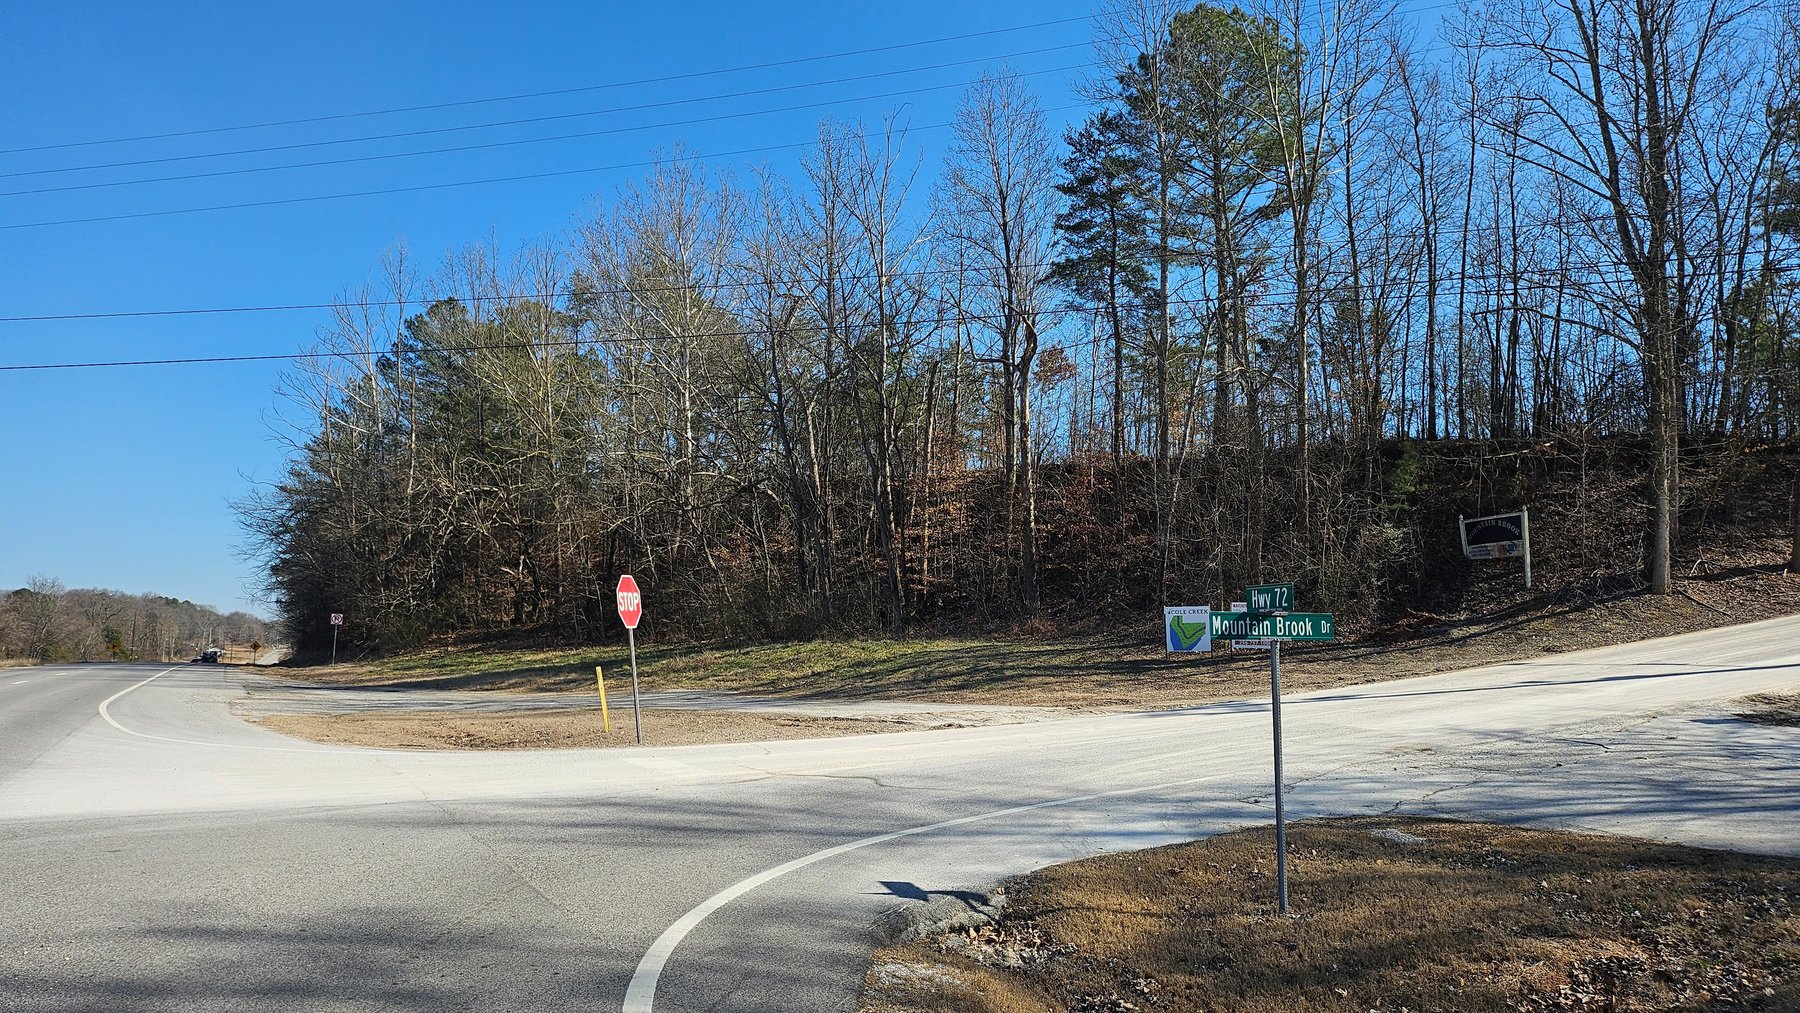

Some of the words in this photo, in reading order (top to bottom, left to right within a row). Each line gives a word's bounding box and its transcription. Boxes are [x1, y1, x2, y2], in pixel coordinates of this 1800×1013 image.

[1498, 519, 1521, 536] BROOK
[618, 592, 639, 611] STOP
[1252, 590, 1271, 609] Hwy
[1275, 587, 1288, 607] 72
[1212, 615, 1271, 635] Mountain
[1276, 616, 1313, 636] Brook
[1321, 620, 1331, 634] Dr
